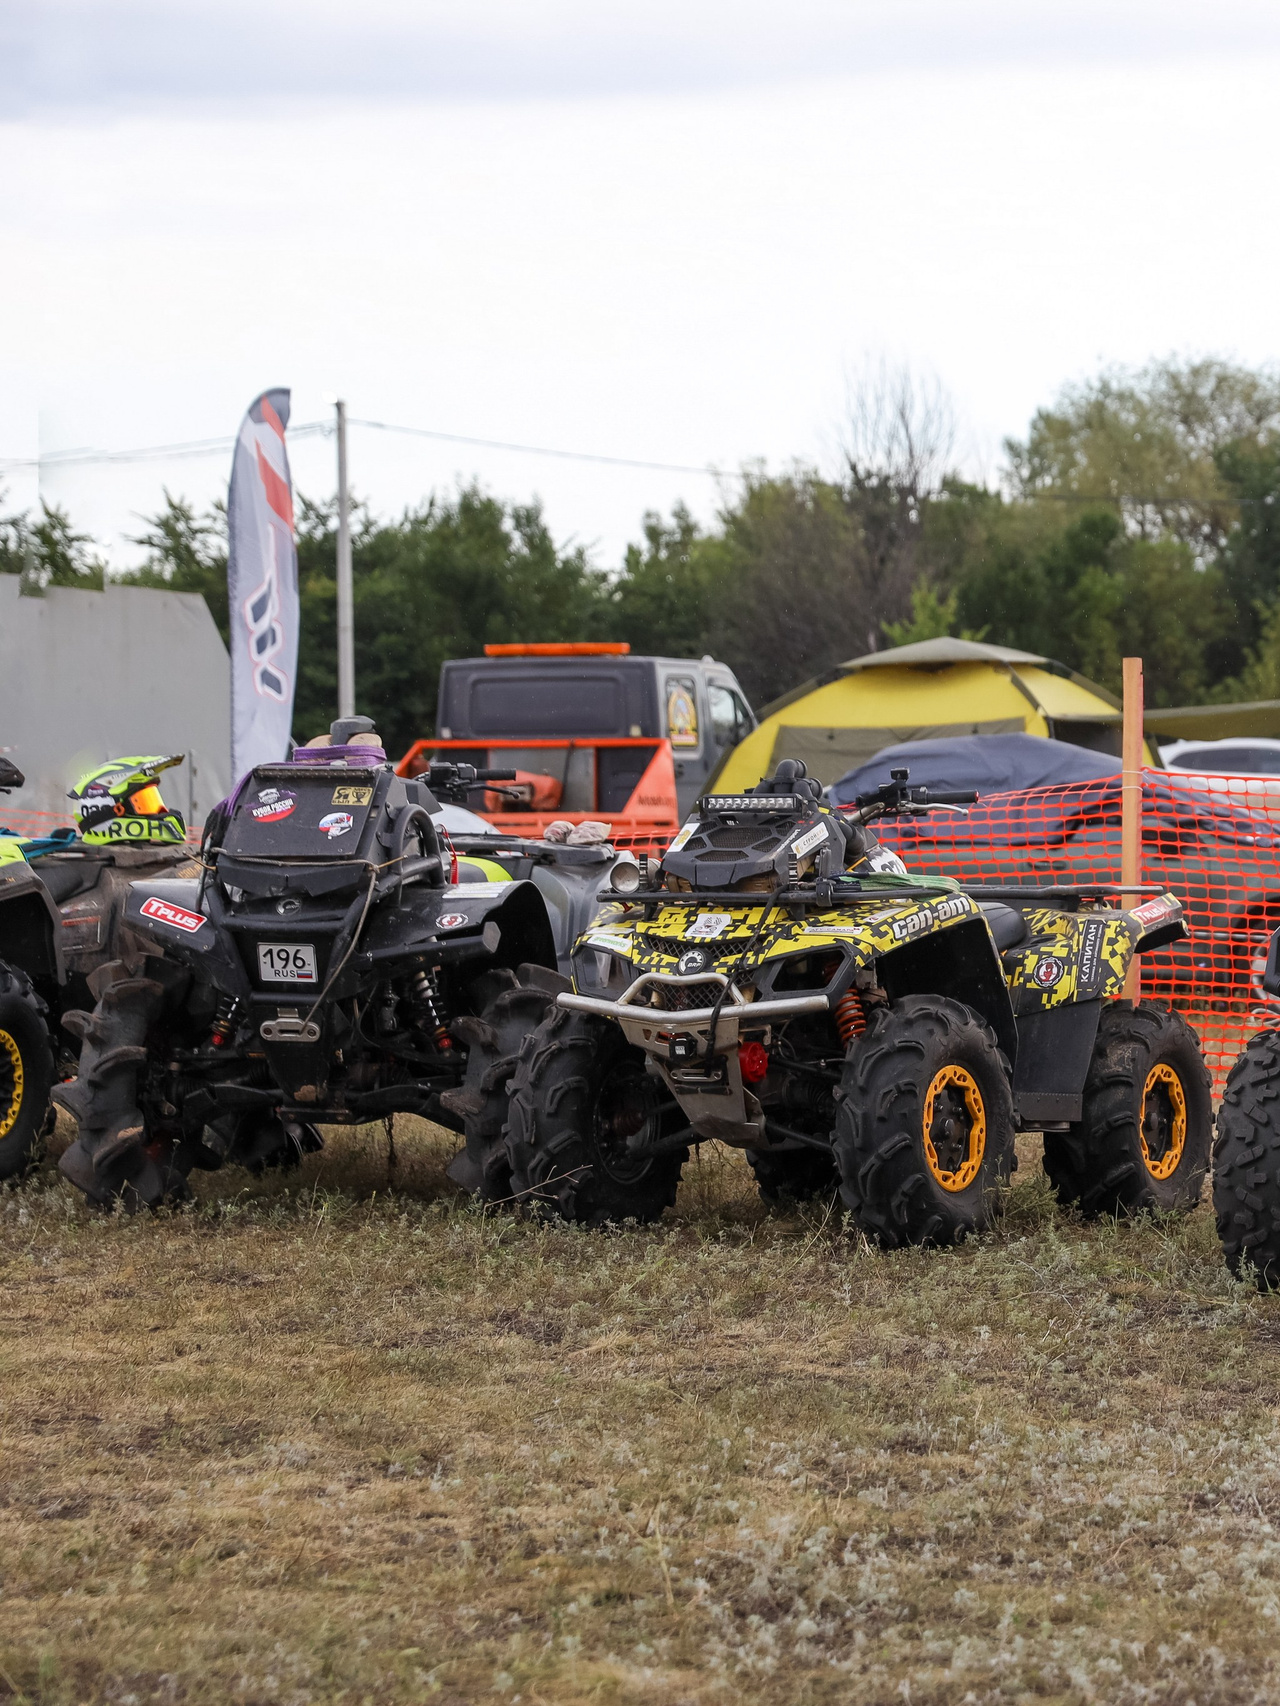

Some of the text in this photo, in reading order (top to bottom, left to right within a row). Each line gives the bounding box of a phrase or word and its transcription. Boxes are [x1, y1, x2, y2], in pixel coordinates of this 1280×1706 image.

[892, 896, 970, 940] can-am
[262, 948, 307, 970] 196
[1081, 924, 1098, 983] КАПИТАН
[274, 970, 296, 978] RUS
